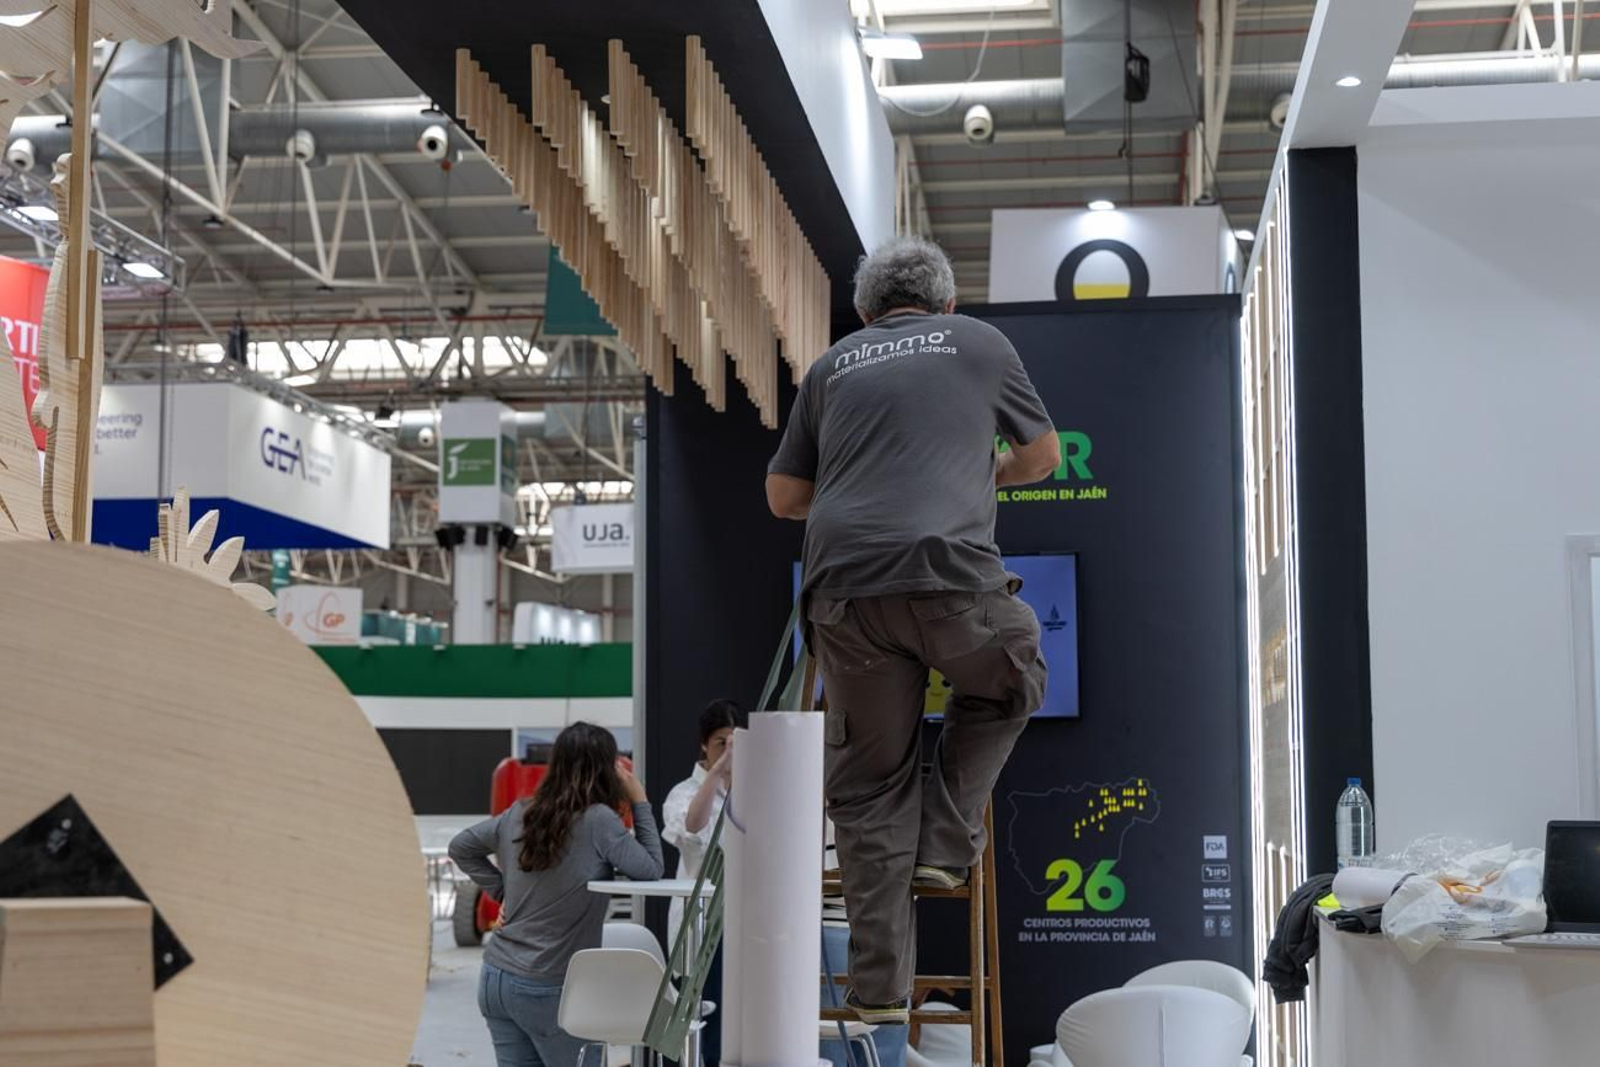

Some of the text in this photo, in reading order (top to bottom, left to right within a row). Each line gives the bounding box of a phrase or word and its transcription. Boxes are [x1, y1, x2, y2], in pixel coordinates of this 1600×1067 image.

[918, 344, 957, 355] ideas
[97, 412, 143, 427] eering
[260, 426, 307, 480] GEA
[1012, 490, 1056, 501] ORIGEN
[1059, 489, 1074, 500] EN
[1077, 485, 1107, 499] JAÉN
[1206, 842, 1225, 852] FDA
[1045, 858, 1125, 912] 26
[1024, 917, 1150, 928] CENTROS PRODUCTIVOS
[1018, 930, 1156, 942] EN LA PROVINCIA DE JAÉN
